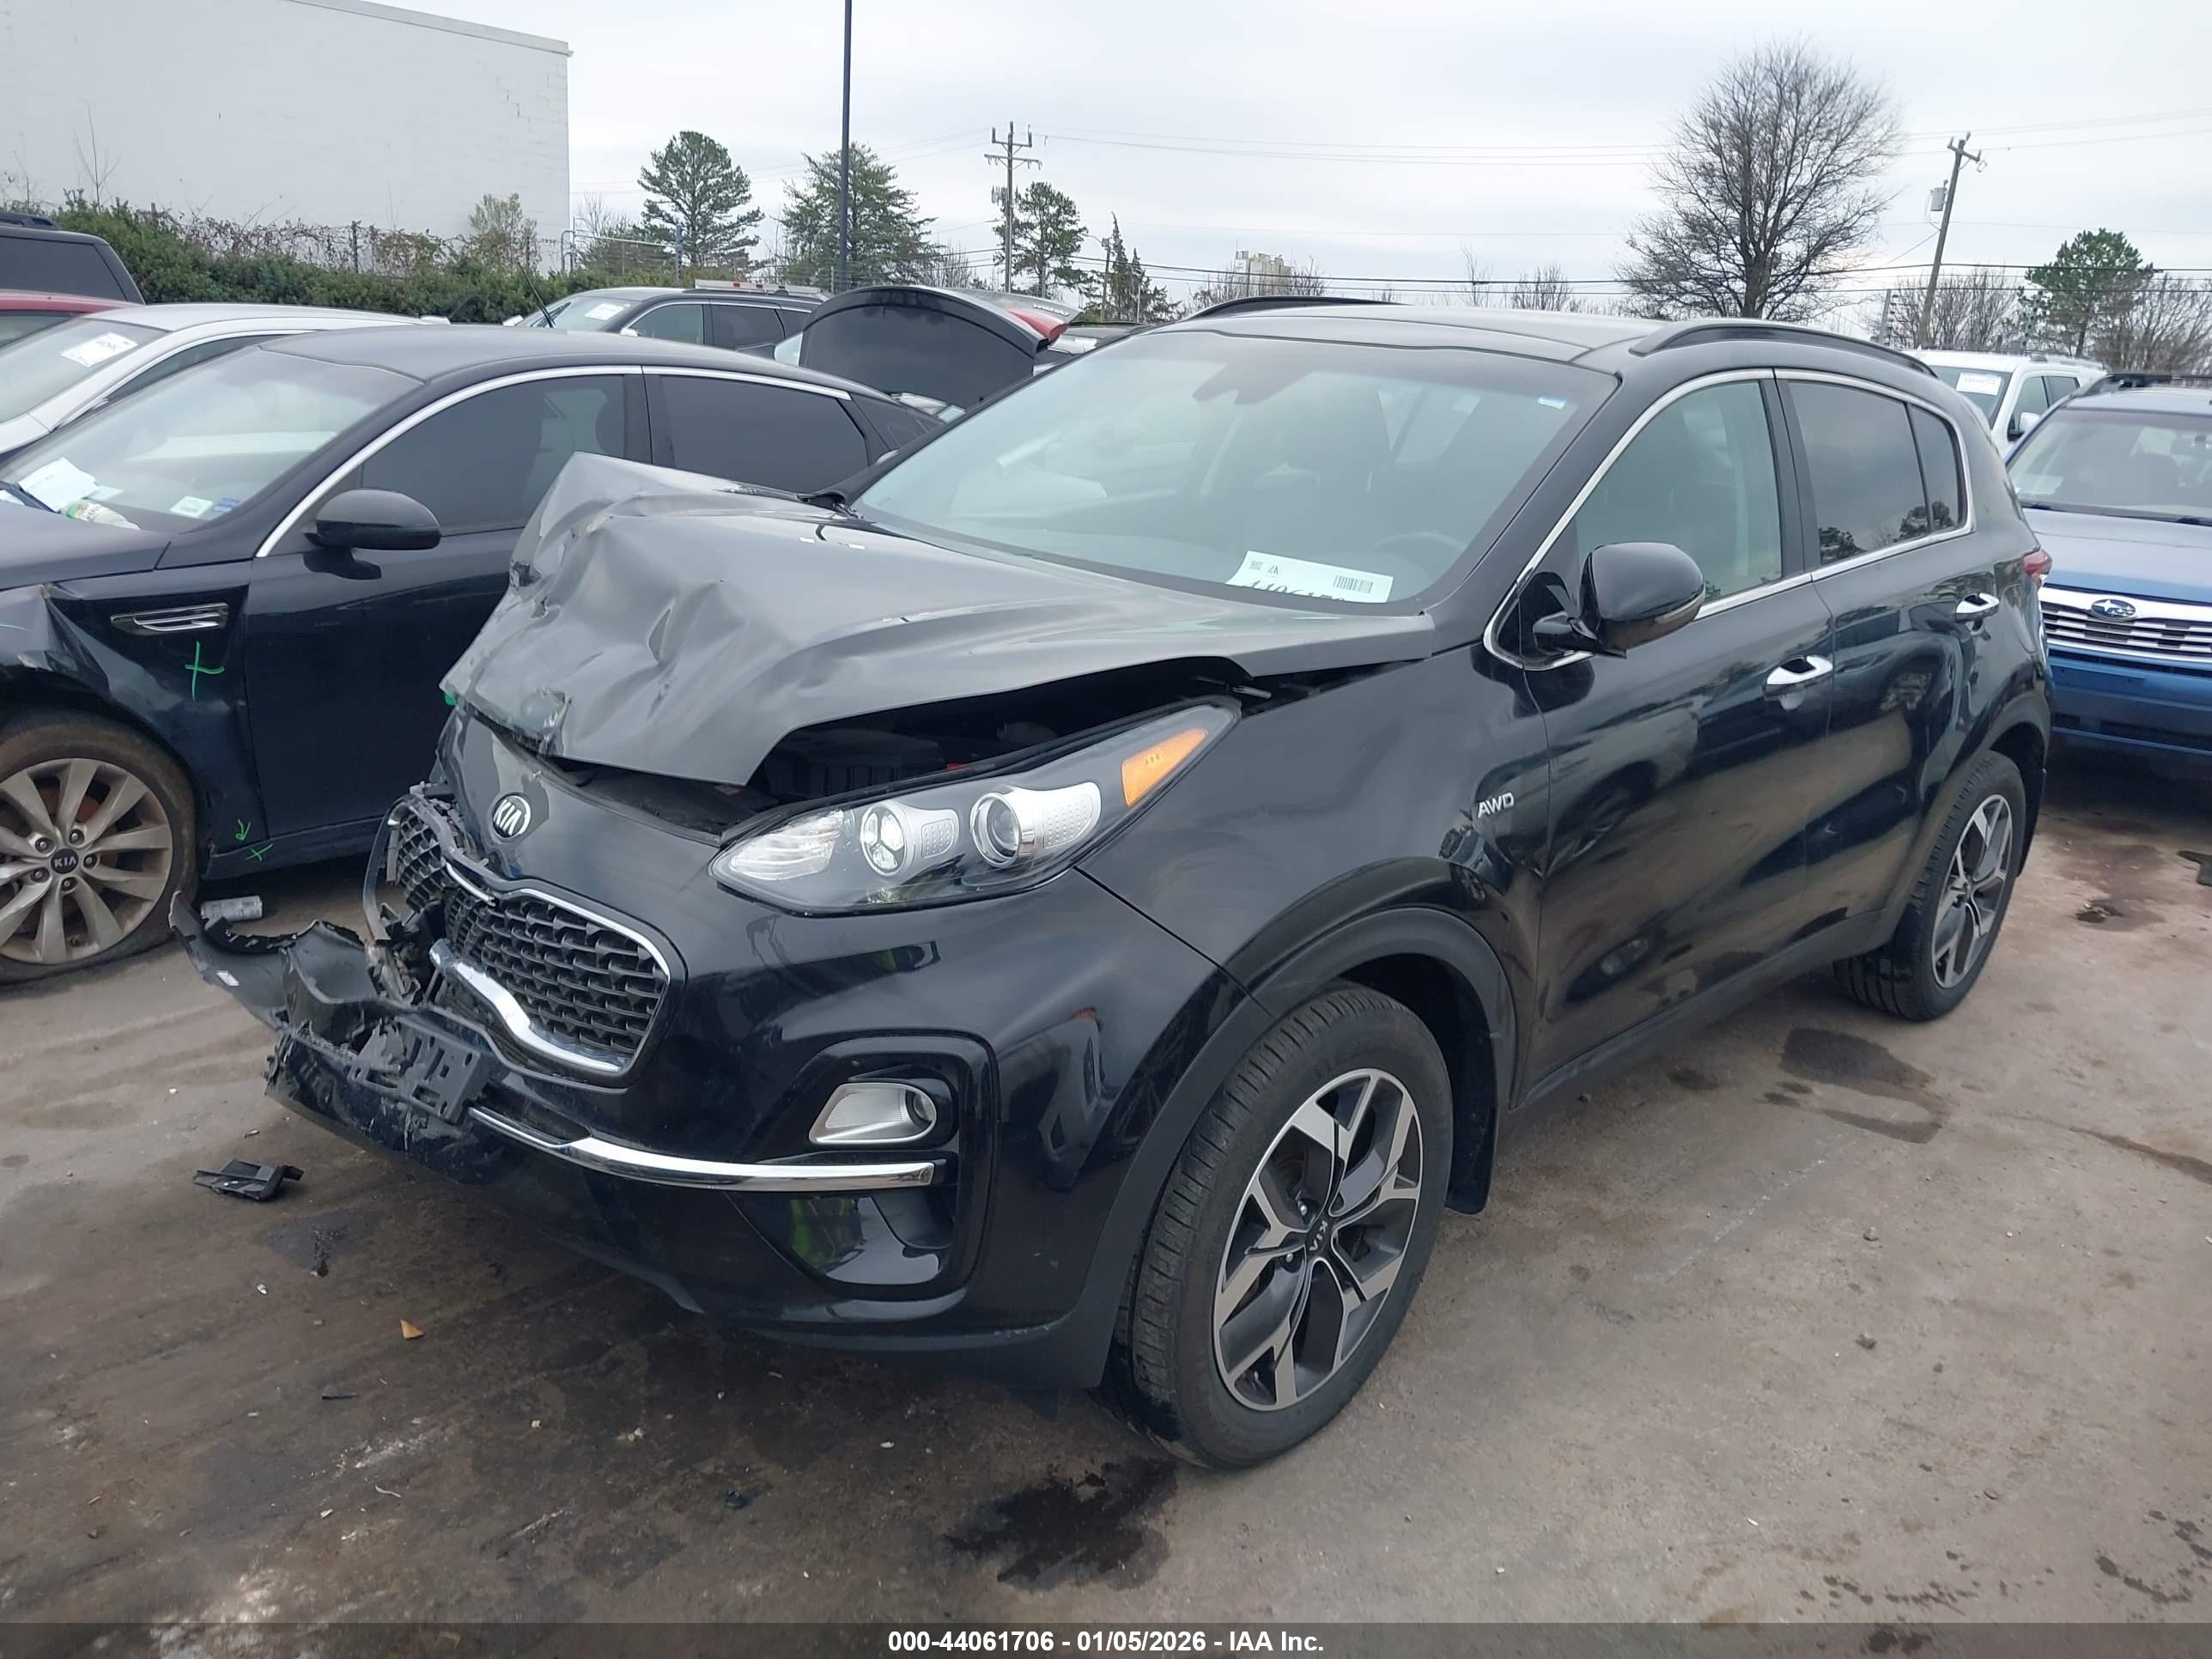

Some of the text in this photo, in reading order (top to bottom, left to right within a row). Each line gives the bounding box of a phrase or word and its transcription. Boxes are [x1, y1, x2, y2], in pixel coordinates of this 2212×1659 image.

[493, 799, 522, 836] KIA
[1477, 792, 1515, 818] AWD
[54, 855, 77, 868] KIA
[1309, 1220, 1328, 1251] KIA
